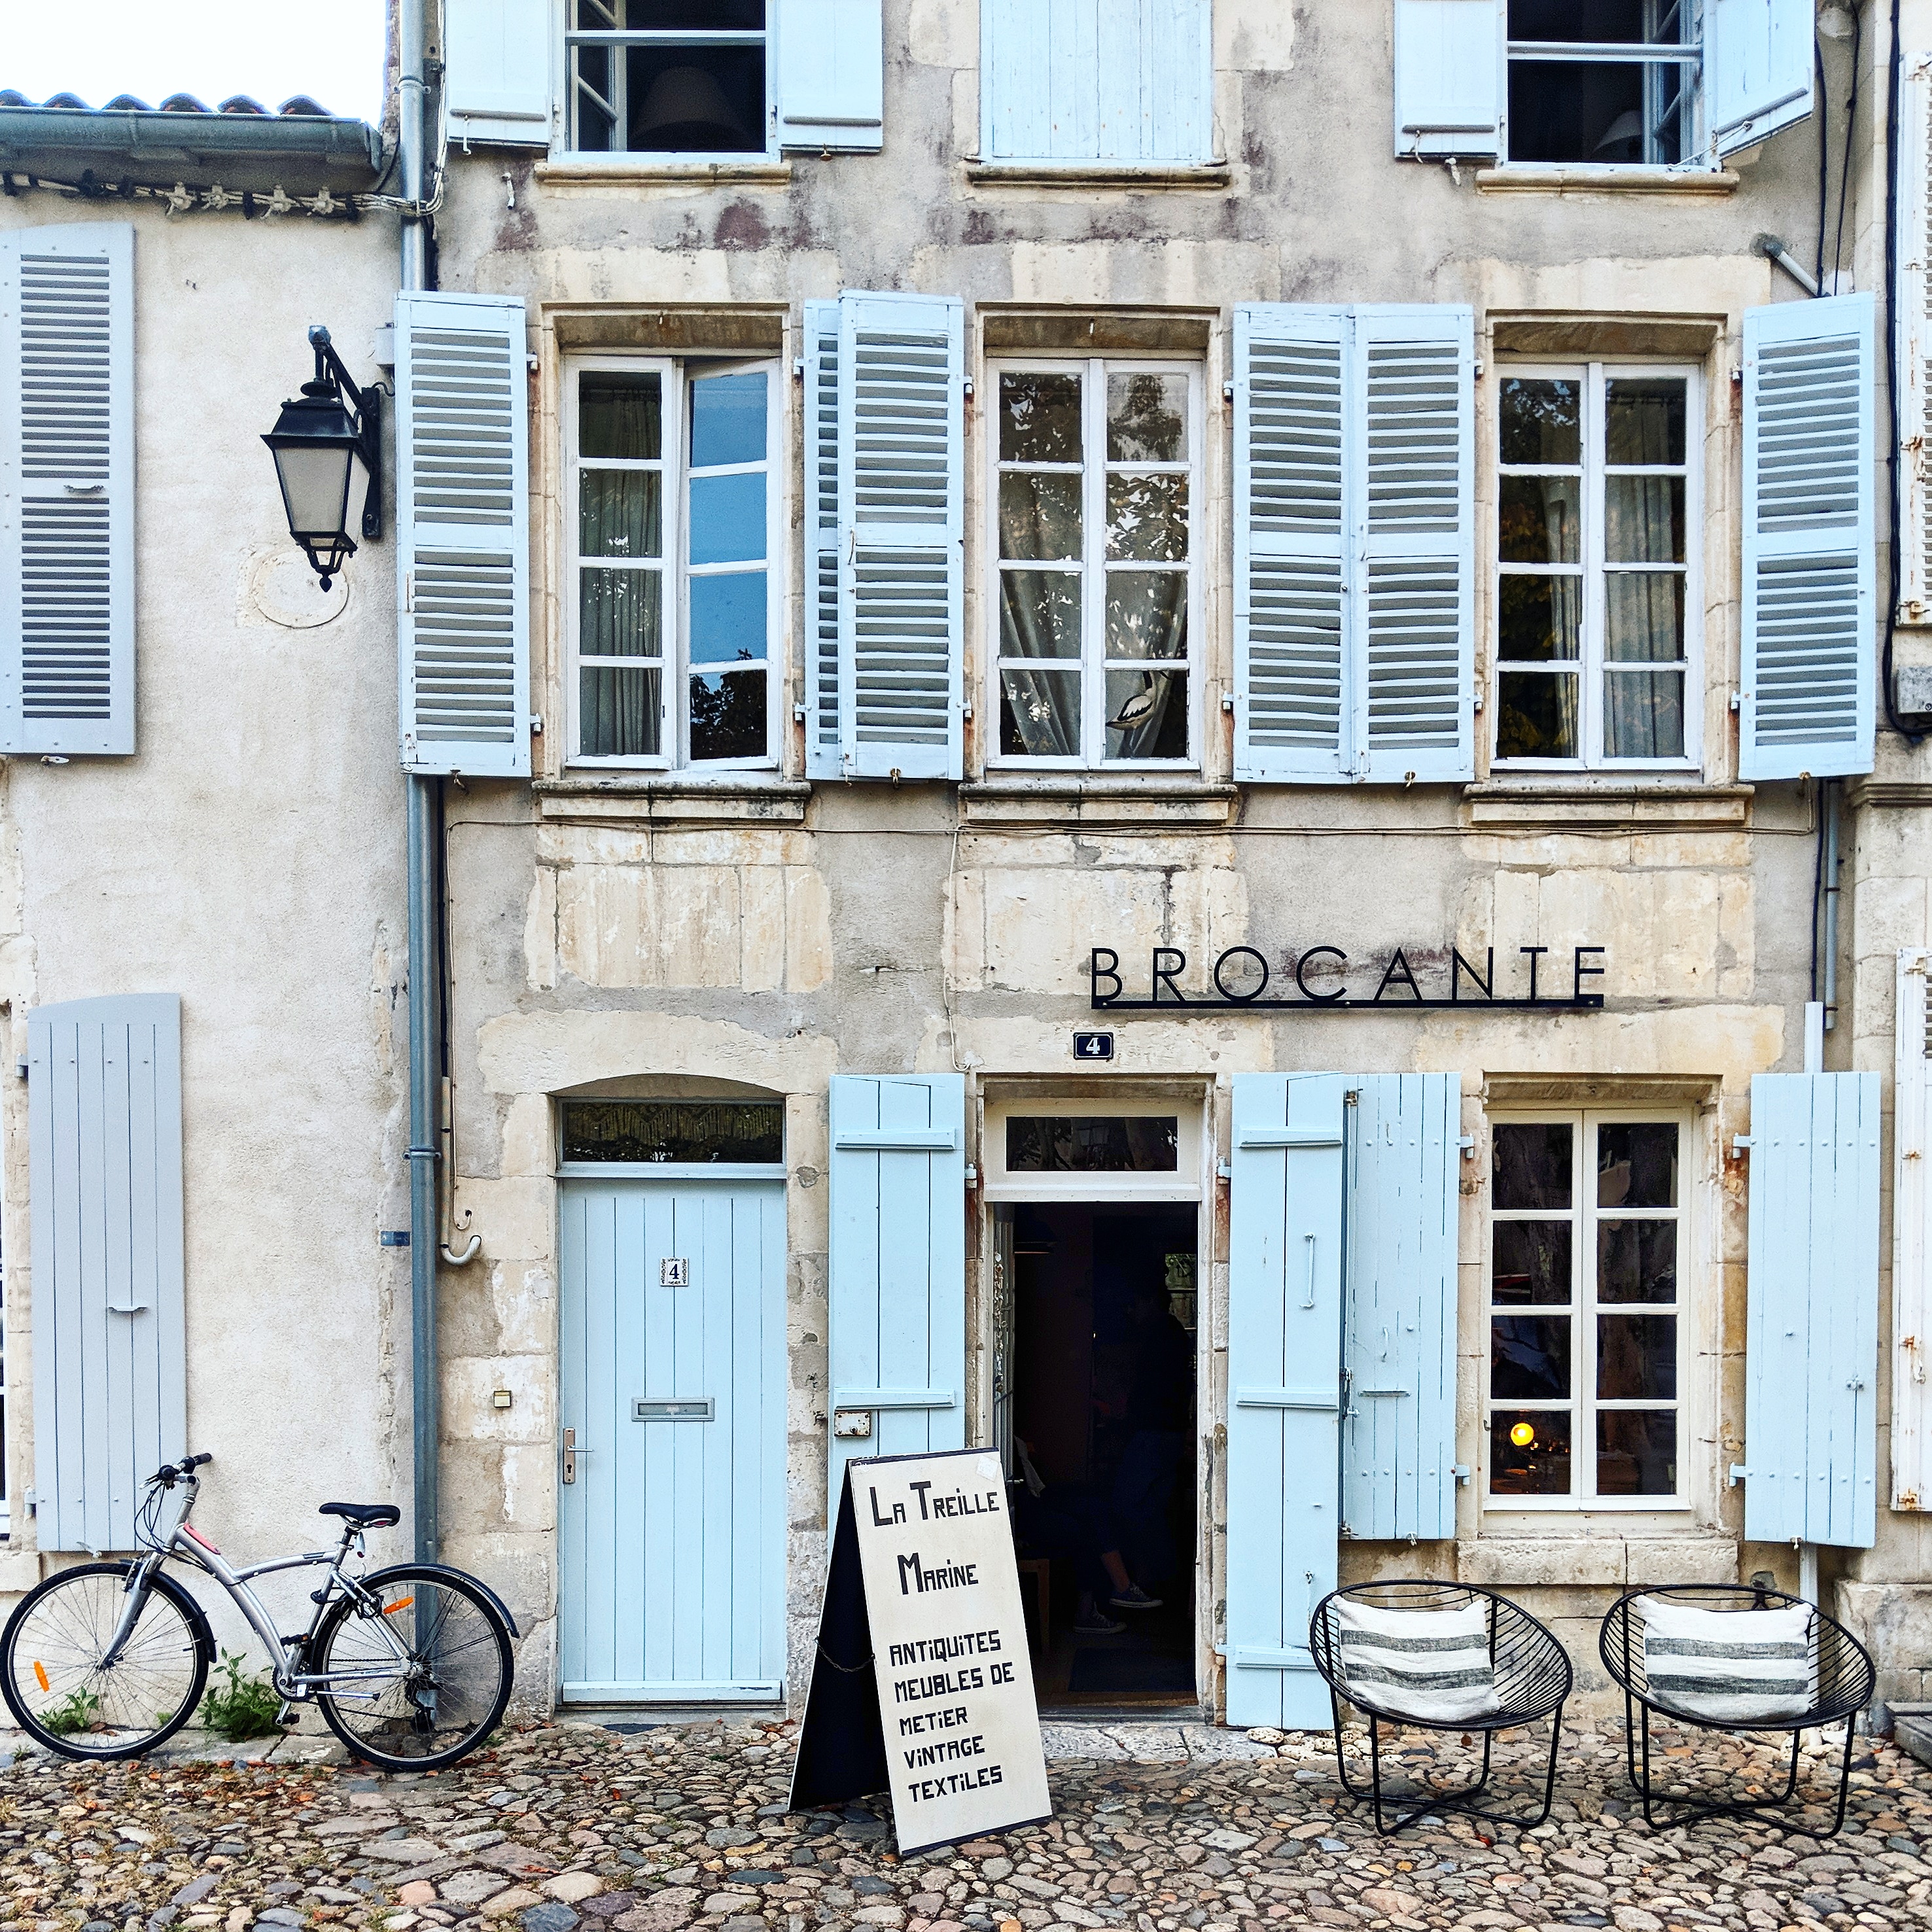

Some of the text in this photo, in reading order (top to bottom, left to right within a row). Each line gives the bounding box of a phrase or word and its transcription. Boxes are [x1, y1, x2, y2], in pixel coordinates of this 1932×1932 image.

[1091, 945, 1605, 1003] BROCANTE
[1085, 1037, 1100, 1055] 4
[669, 1263, 680, 1280] 4
[869, 1486, 907, 1527] LA
[894, 1661, 1015, 1703] MEUBLES DE
